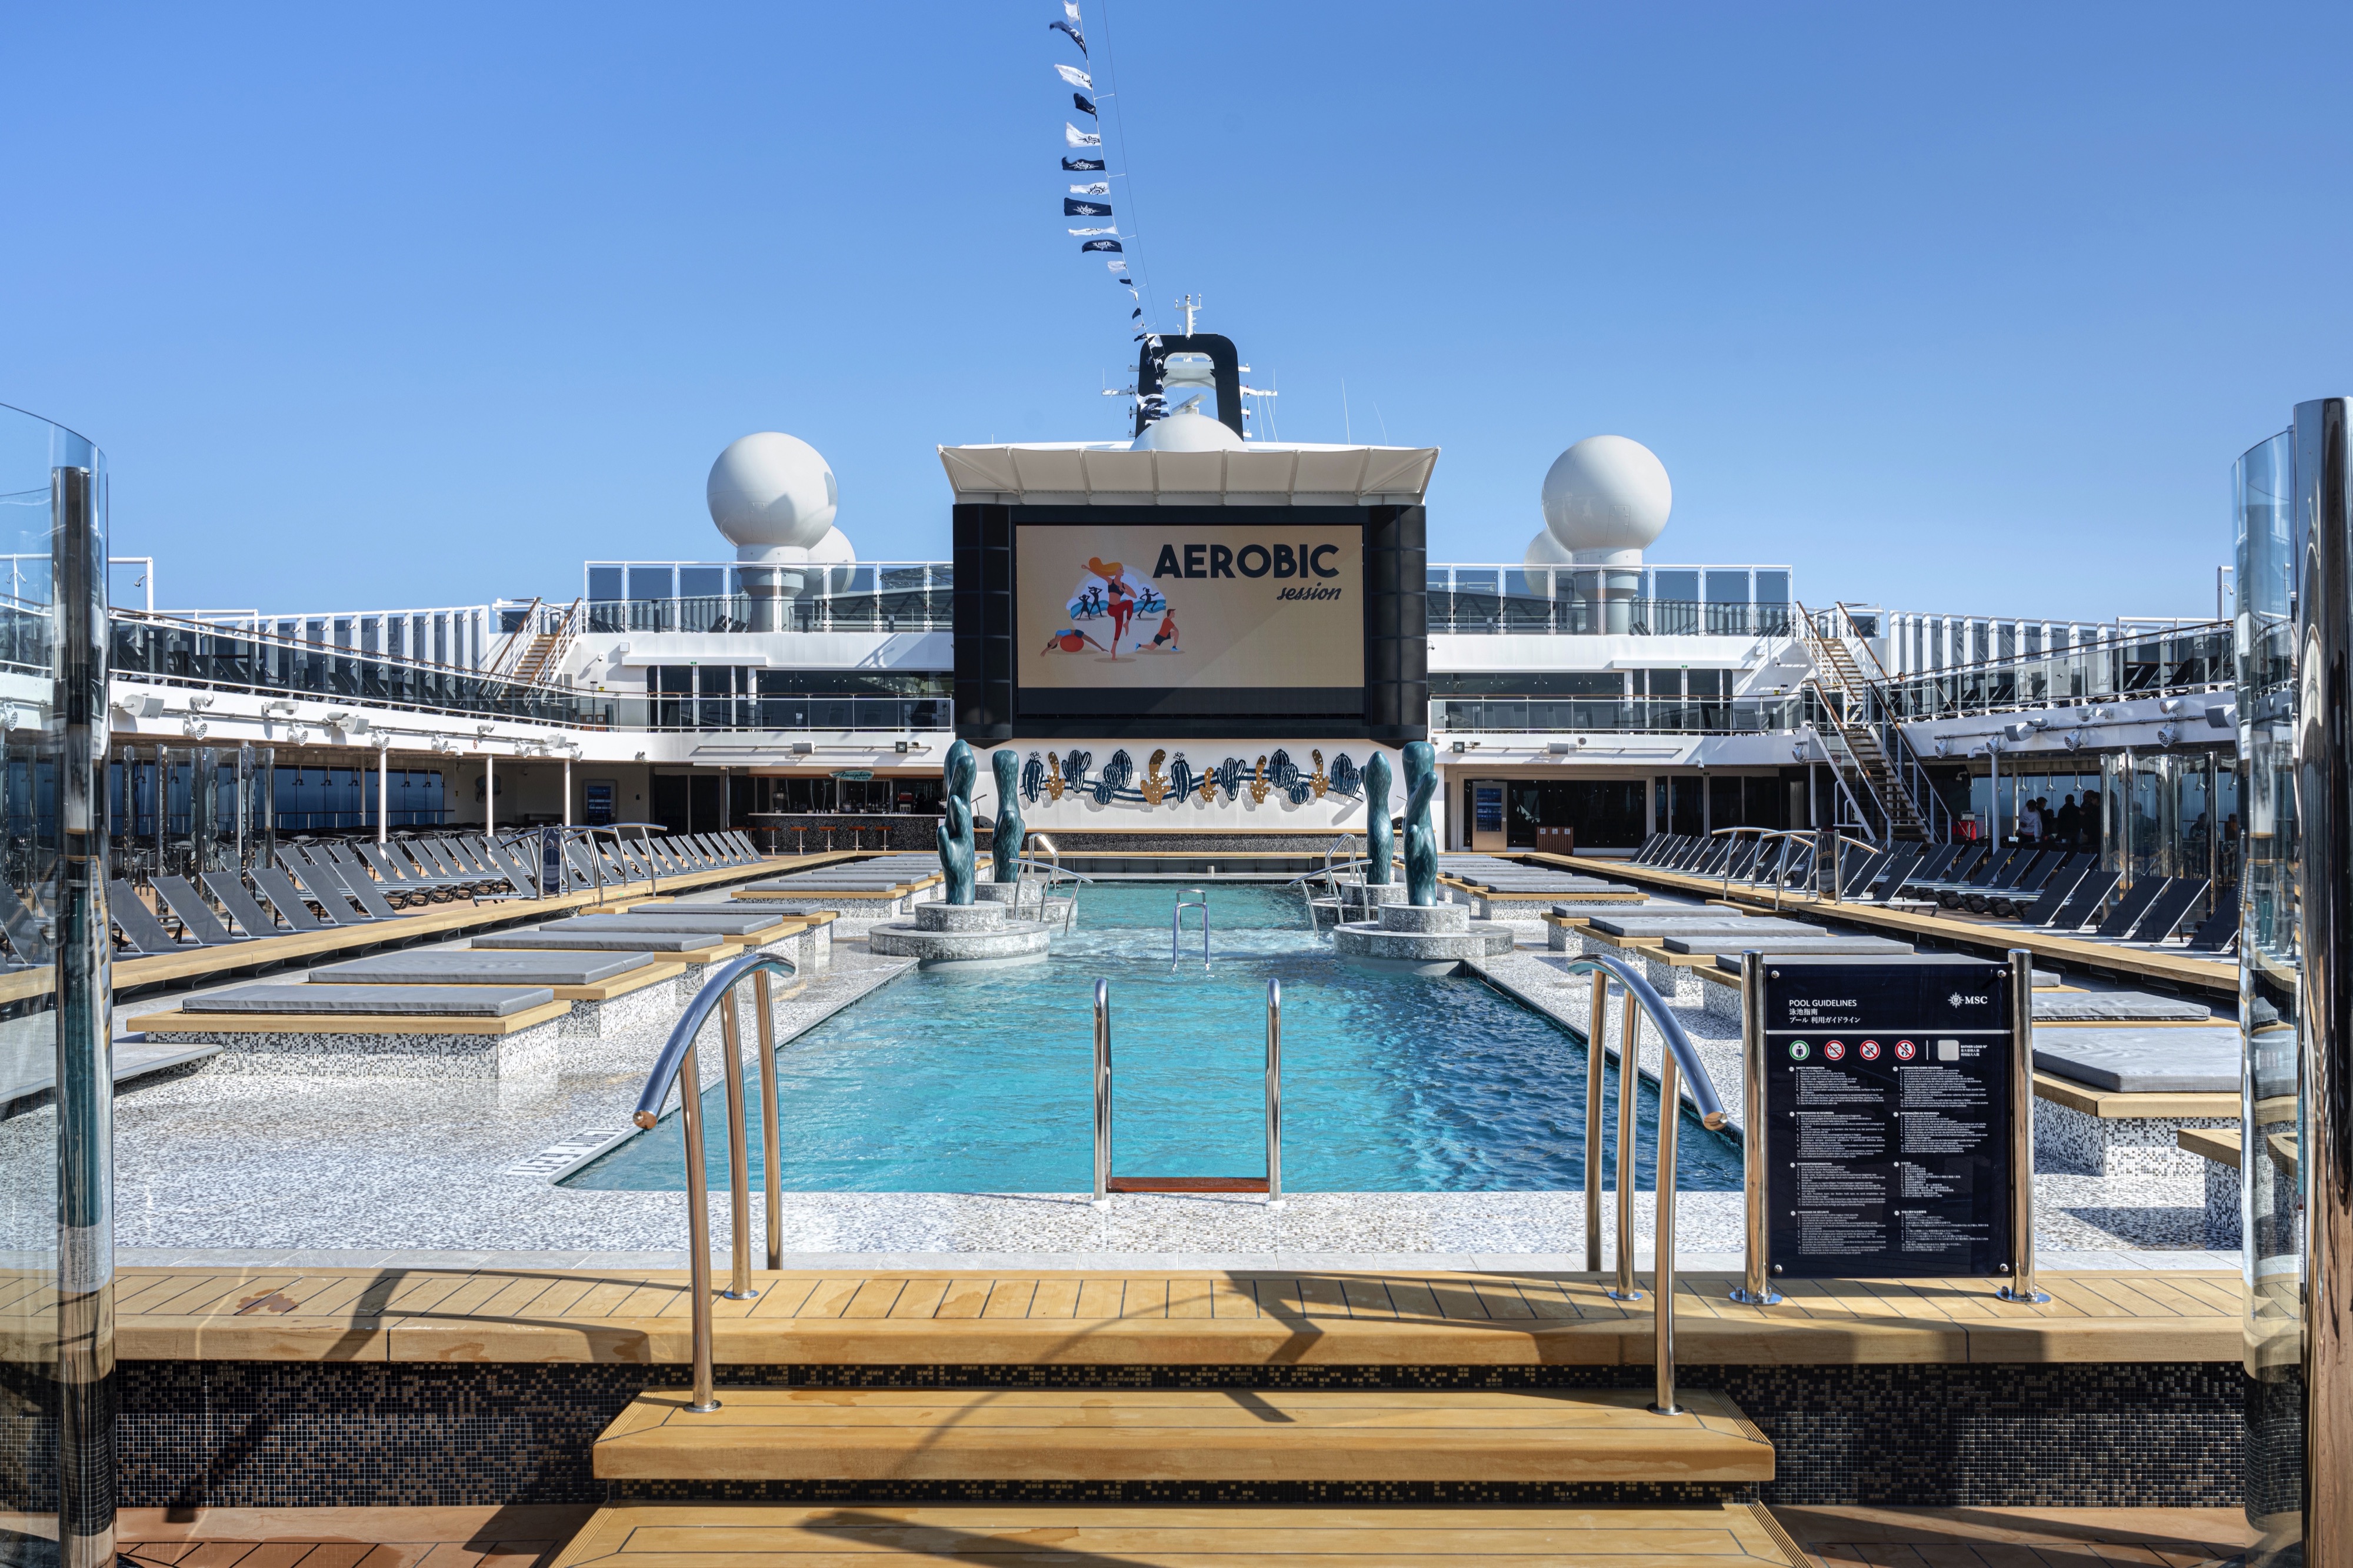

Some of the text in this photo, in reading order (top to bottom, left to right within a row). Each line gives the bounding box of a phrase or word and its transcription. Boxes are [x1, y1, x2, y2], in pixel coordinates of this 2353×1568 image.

[1153, 543, 1339, 579] AEROBIC
[1277, 582, 1341, 600] session
[1965, 996, 1988, 1004] MSC
